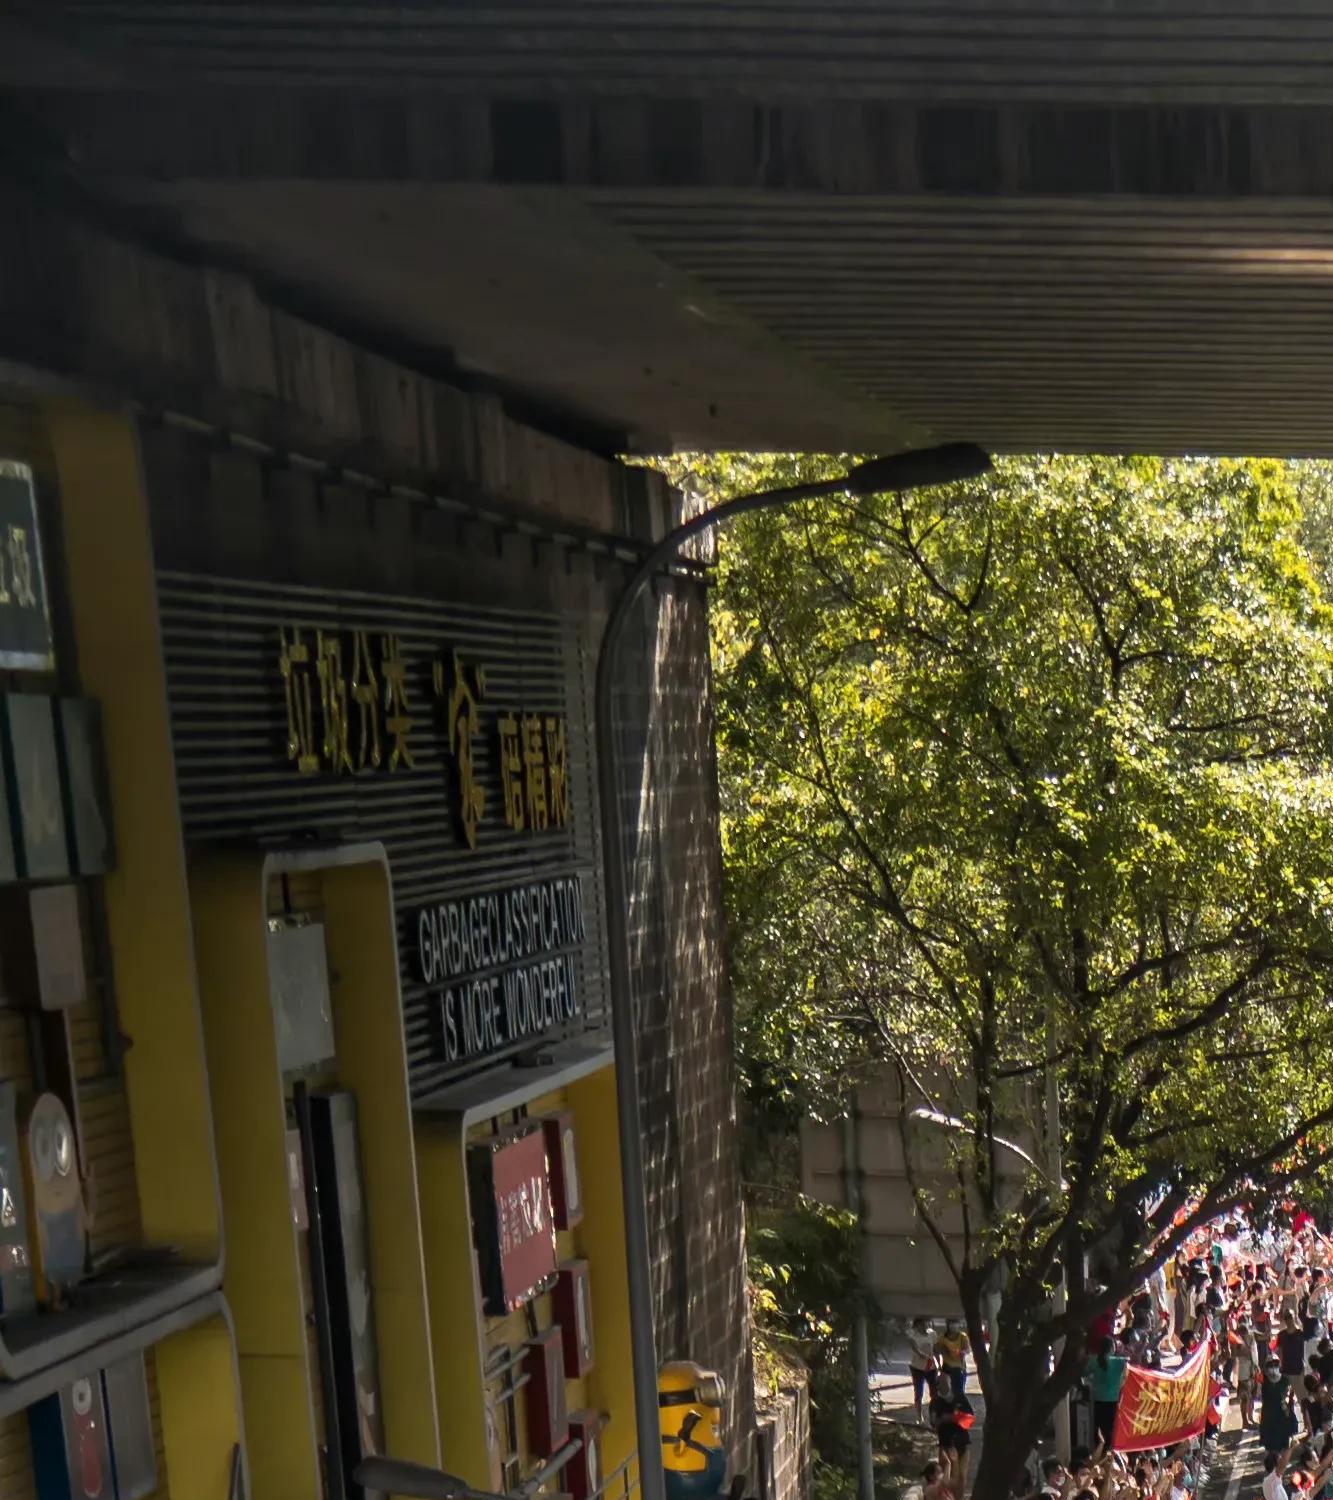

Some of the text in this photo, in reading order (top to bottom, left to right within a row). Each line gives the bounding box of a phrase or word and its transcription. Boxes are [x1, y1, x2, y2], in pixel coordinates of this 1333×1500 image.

[280, 626, 415, 776] 垃圾分类
[418, 878, 586, 984] GARBAGECLASSIFICATION
[439, 954, 581, 1061] IS MORE WONDERFUL
